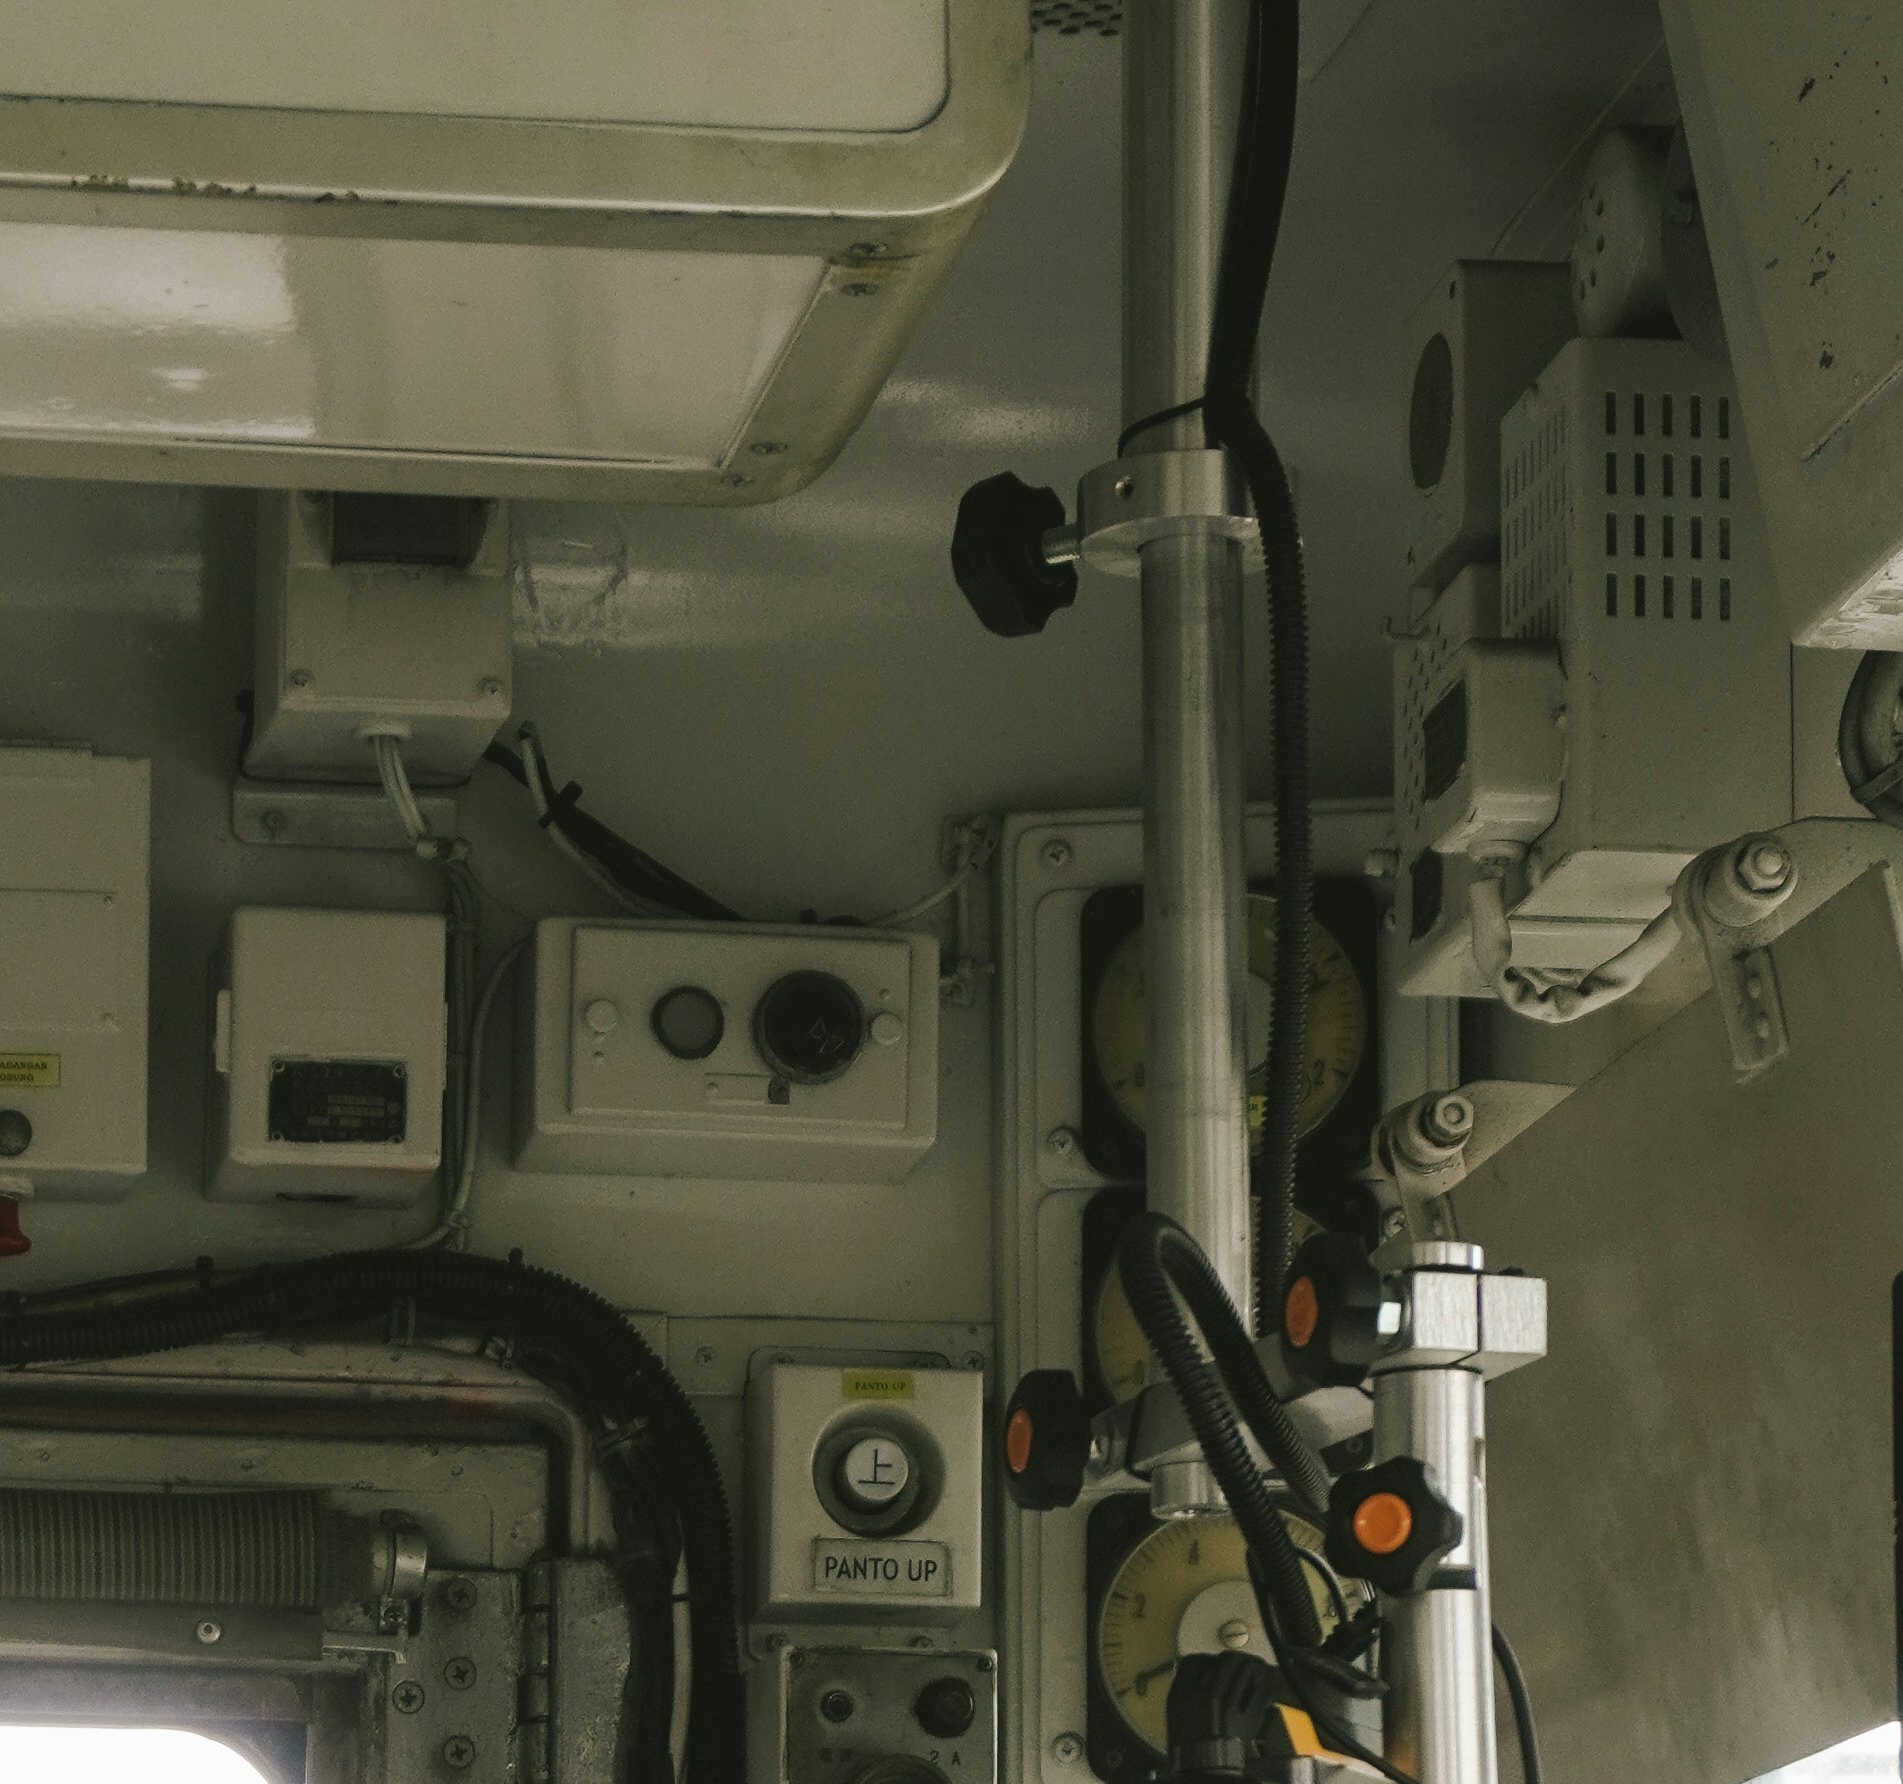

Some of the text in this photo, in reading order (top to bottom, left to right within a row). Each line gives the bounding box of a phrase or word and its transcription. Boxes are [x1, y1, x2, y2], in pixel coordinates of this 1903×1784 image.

[854, 1381, 906, 1391] PANTO UP
[857, 1447, 896, 1486] 上
[824, 1556, 938, 1582] PANTO UP
